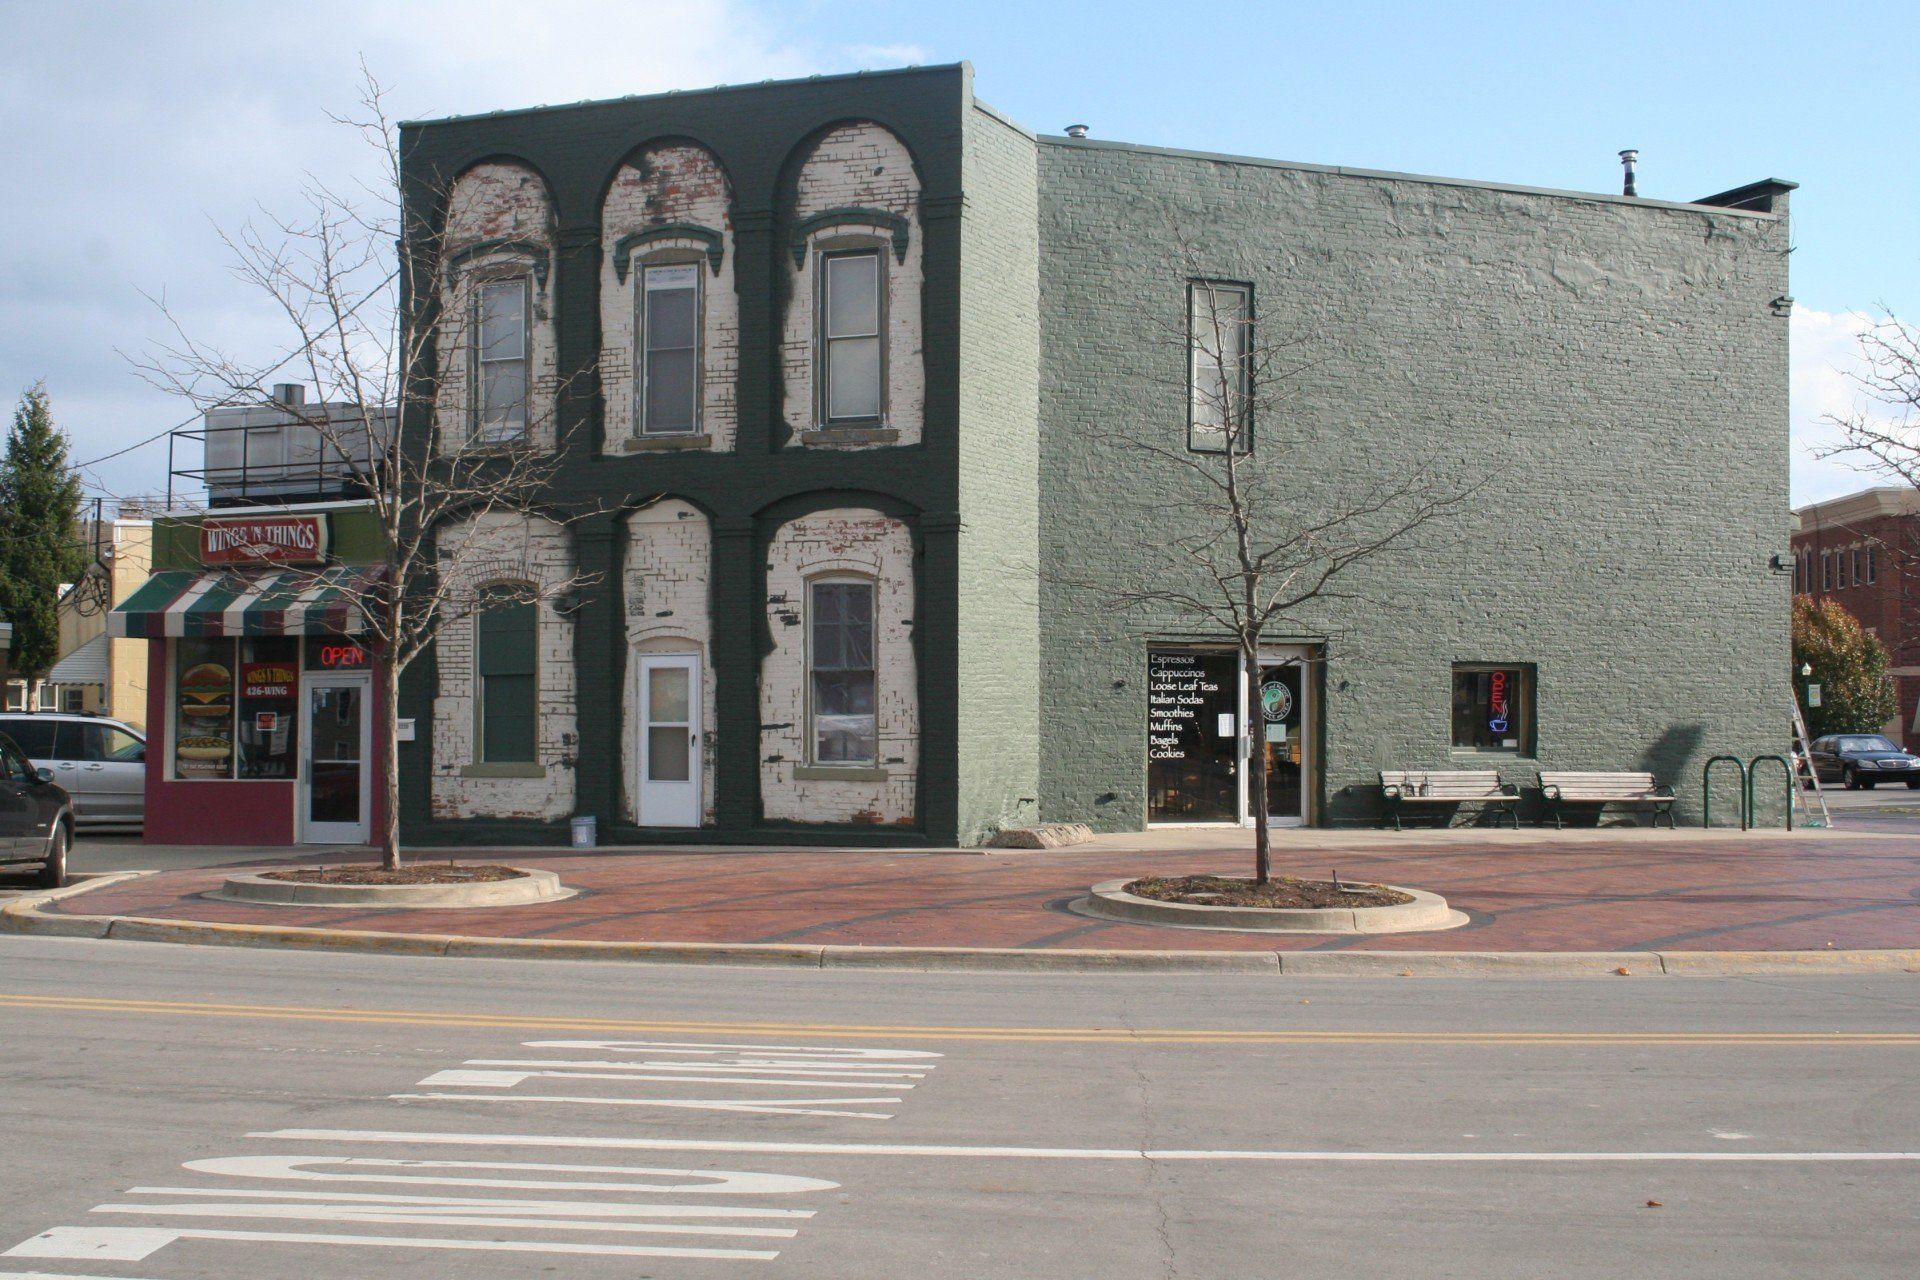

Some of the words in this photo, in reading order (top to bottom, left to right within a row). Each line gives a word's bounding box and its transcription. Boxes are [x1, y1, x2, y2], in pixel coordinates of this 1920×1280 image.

[207, 526, 248, 553] WINGS
[265, 523, 315, 550] THINGS
[321, 645, 364, 667] OPEN
[1151, 653, 1195, 669] Espressos
[1150, 667, 1206, 682] Cappuccinos
[247, 686, 288, 696] 426-WING
[1150, 681, 1177, 691] Loose
[1178, 679, 1198, 691] Leaf
[1199, 681, 1219, 691] Teas
[1491, 671, 1505, 713] OPEN
[1150, 692, 1176, 704] Italian
[1177, 692, 1204, 705] Sodas
[1150, 705, 1195, 718] Smoothies
[1150, 719, 1183, 731] Muffins
[1150, 733, 1179, 748] Bagels
[1149, 746, 1185, 758] Cookies
[0, 1155, 843, 1280] ONL
